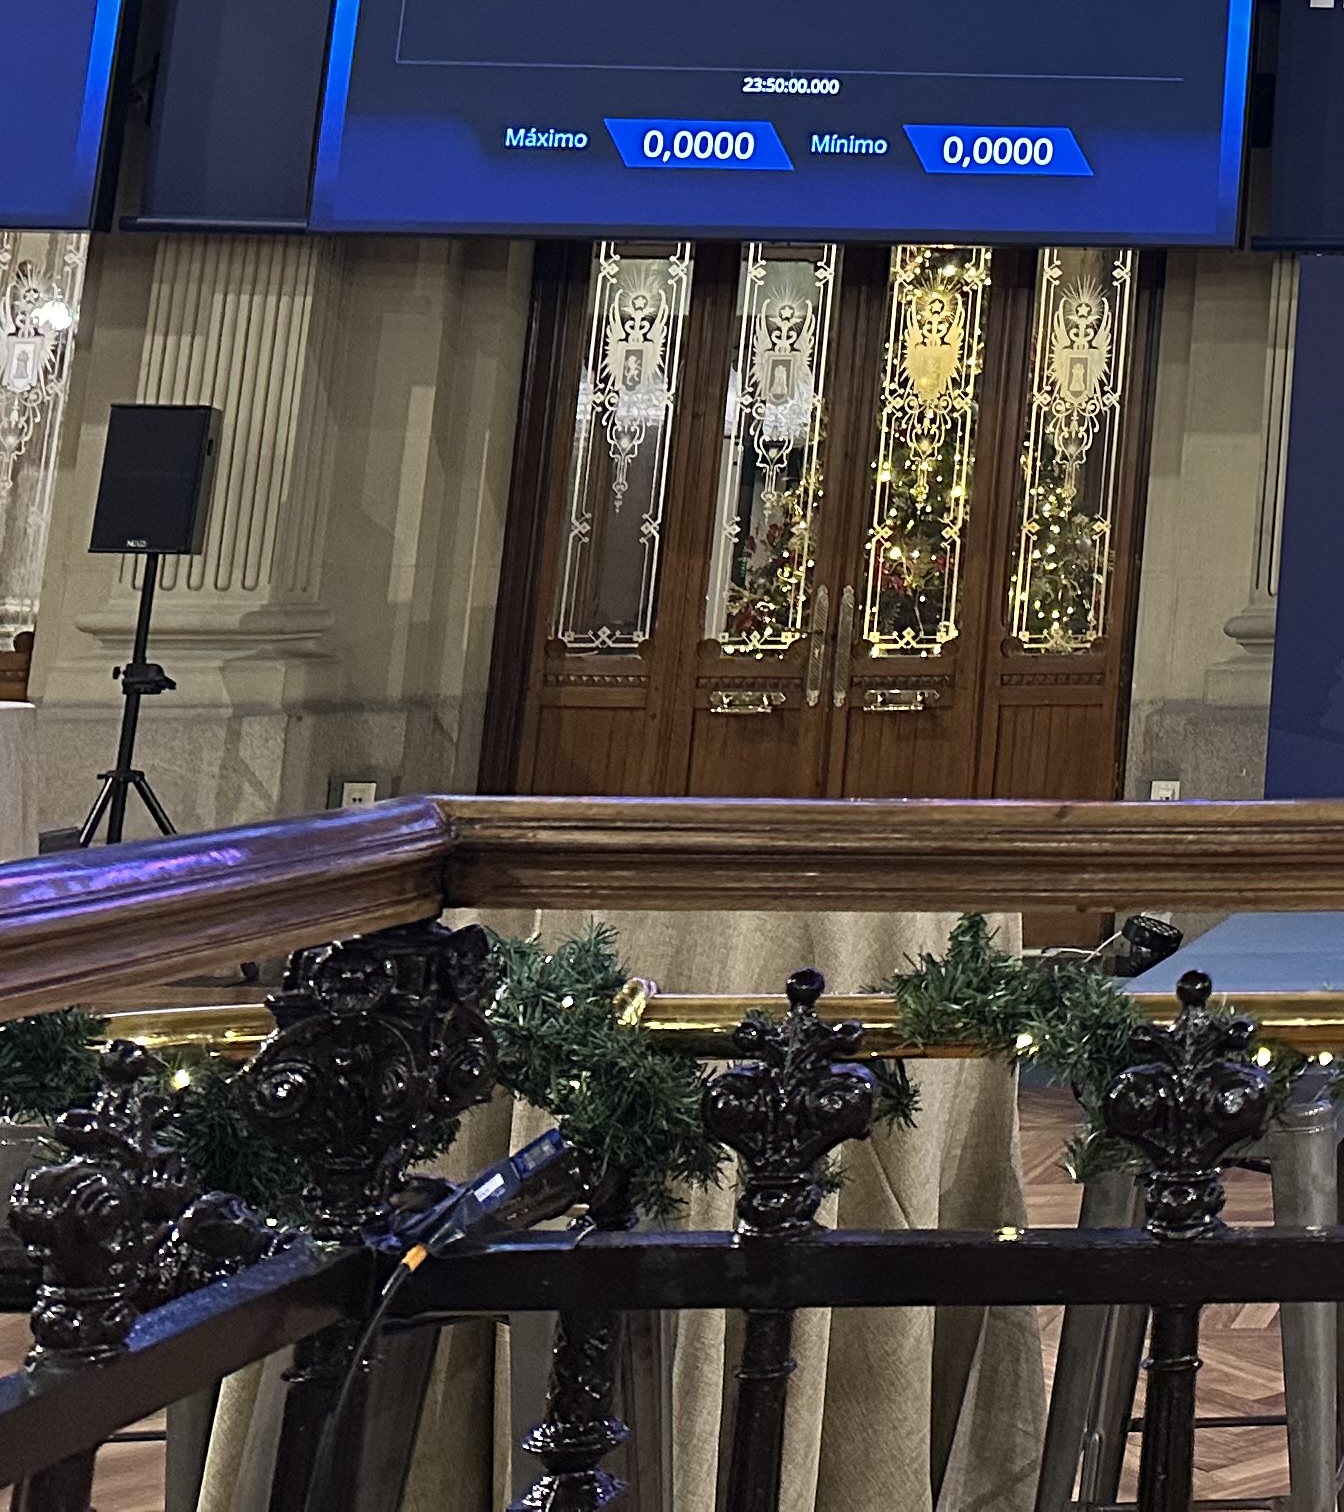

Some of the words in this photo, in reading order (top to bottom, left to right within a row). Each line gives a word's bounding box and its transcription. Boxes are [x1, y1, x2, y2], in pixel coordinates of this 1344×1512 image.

[743, 77, 839, 94] 23:50:00.000
[506, 128, 587, 147] Máximo
[644, 130, 754, 163] 0,0000
[811, 134, 887, 153] Mínimo
[944, 136, 1053, 167] 0,0000
